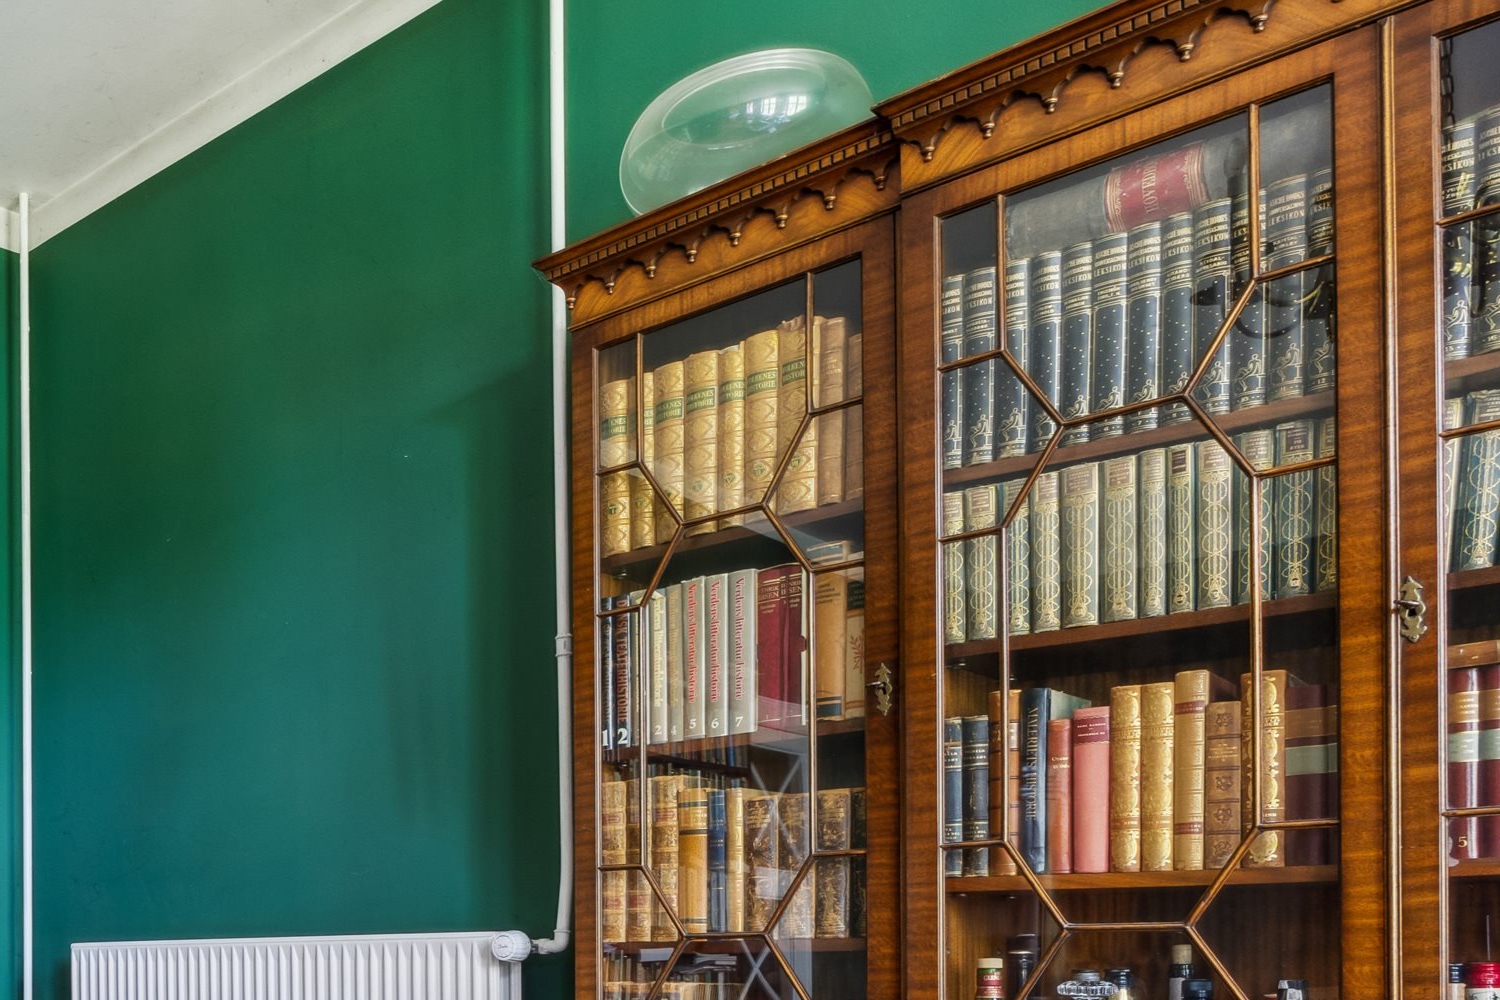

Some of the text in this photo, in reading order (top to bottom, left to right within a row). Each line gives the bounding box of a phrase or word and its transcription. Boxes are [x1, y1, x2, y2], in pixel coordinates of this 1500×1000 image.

[616, 637, 628, 723] TEATERHISTORIE
[689, 719, 696, 729] 5
[711, 718, 719, 729] 6
[735, 716, 743, 727] 7
[602, 729, 609, 746] 1
[617, 727, 628, 745] 2
[1026, 706, 1039, 820] MALERIETS HISTORIE
